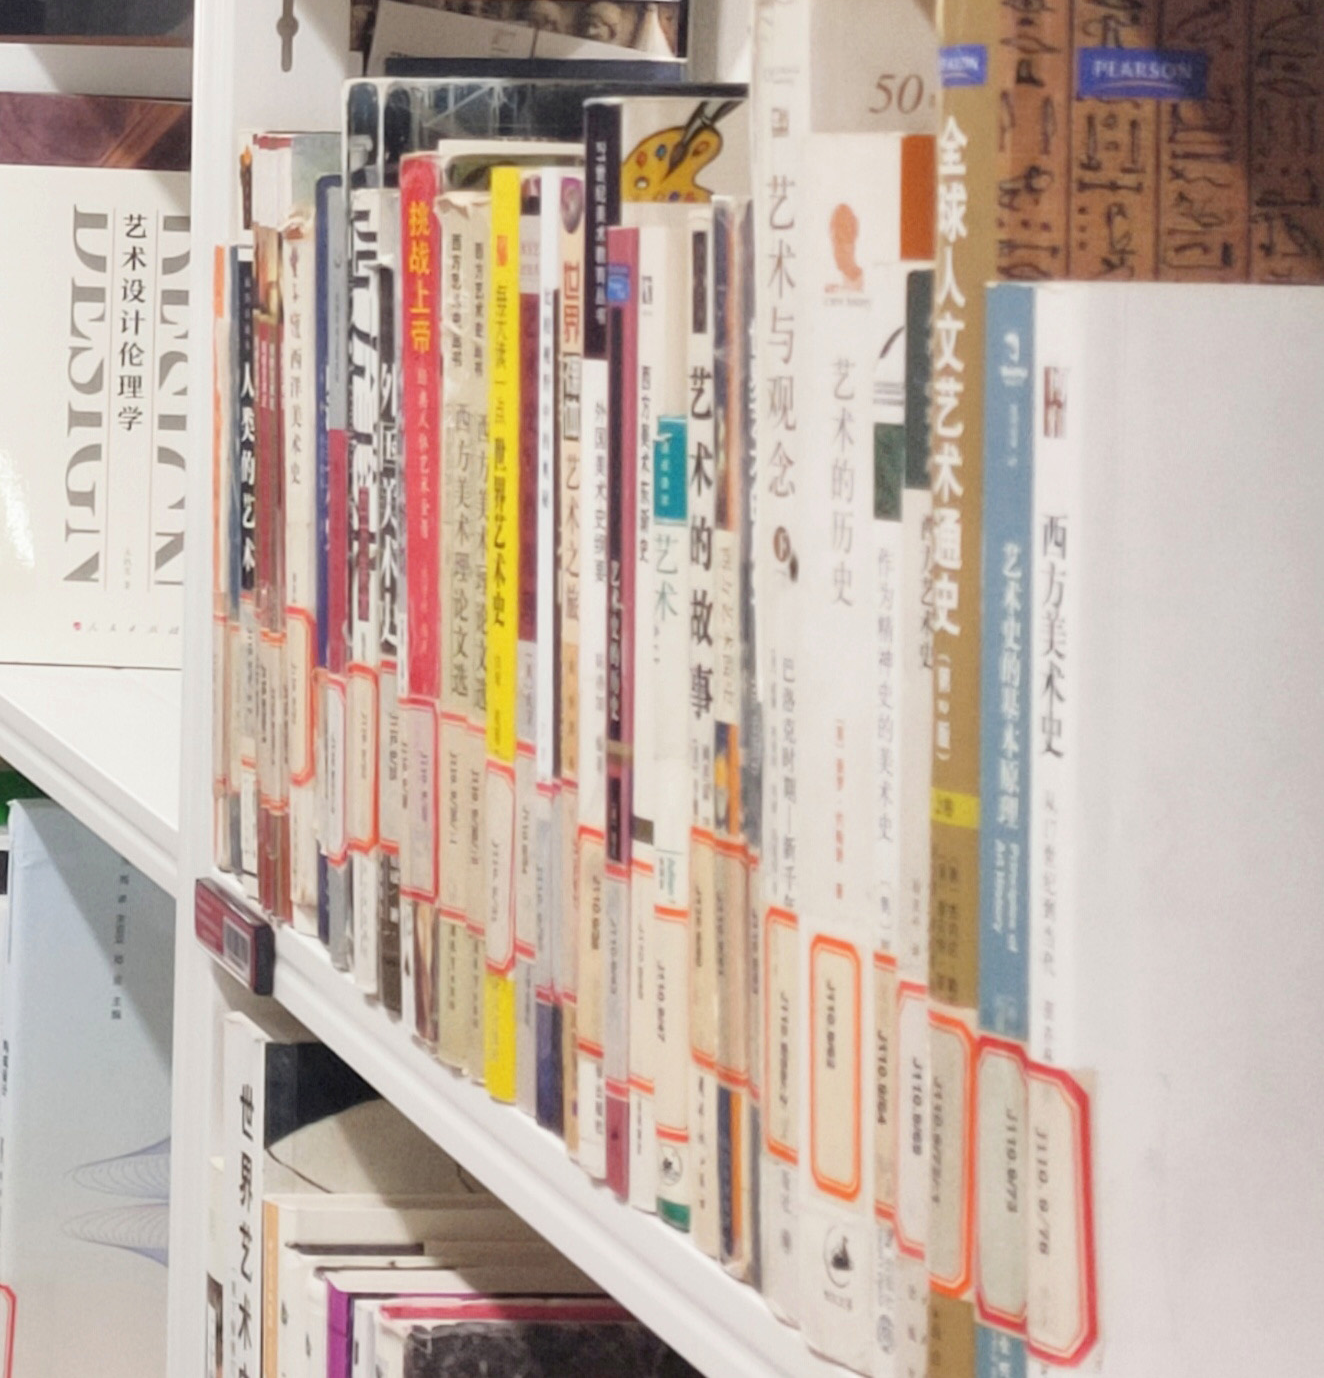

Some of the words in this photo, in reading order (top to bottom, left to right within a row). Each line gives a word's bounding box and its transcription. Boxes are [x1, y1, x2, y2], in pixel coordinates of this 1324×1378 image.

[868, 74, 925, 114] 50
[1091, 59, 1195, 80] PEARSON
[118, 213, 149, 432] 艺术设计伦理学
[765, 172, 798, 500] 艺术与观念
[655, 534, 679, 622] 艺术
[689, 365, 714, 720] 艺术的故事
[830, 357, 857, 607] 艺术的历史
[1040, 514, 1070, 759] 西方美术史
